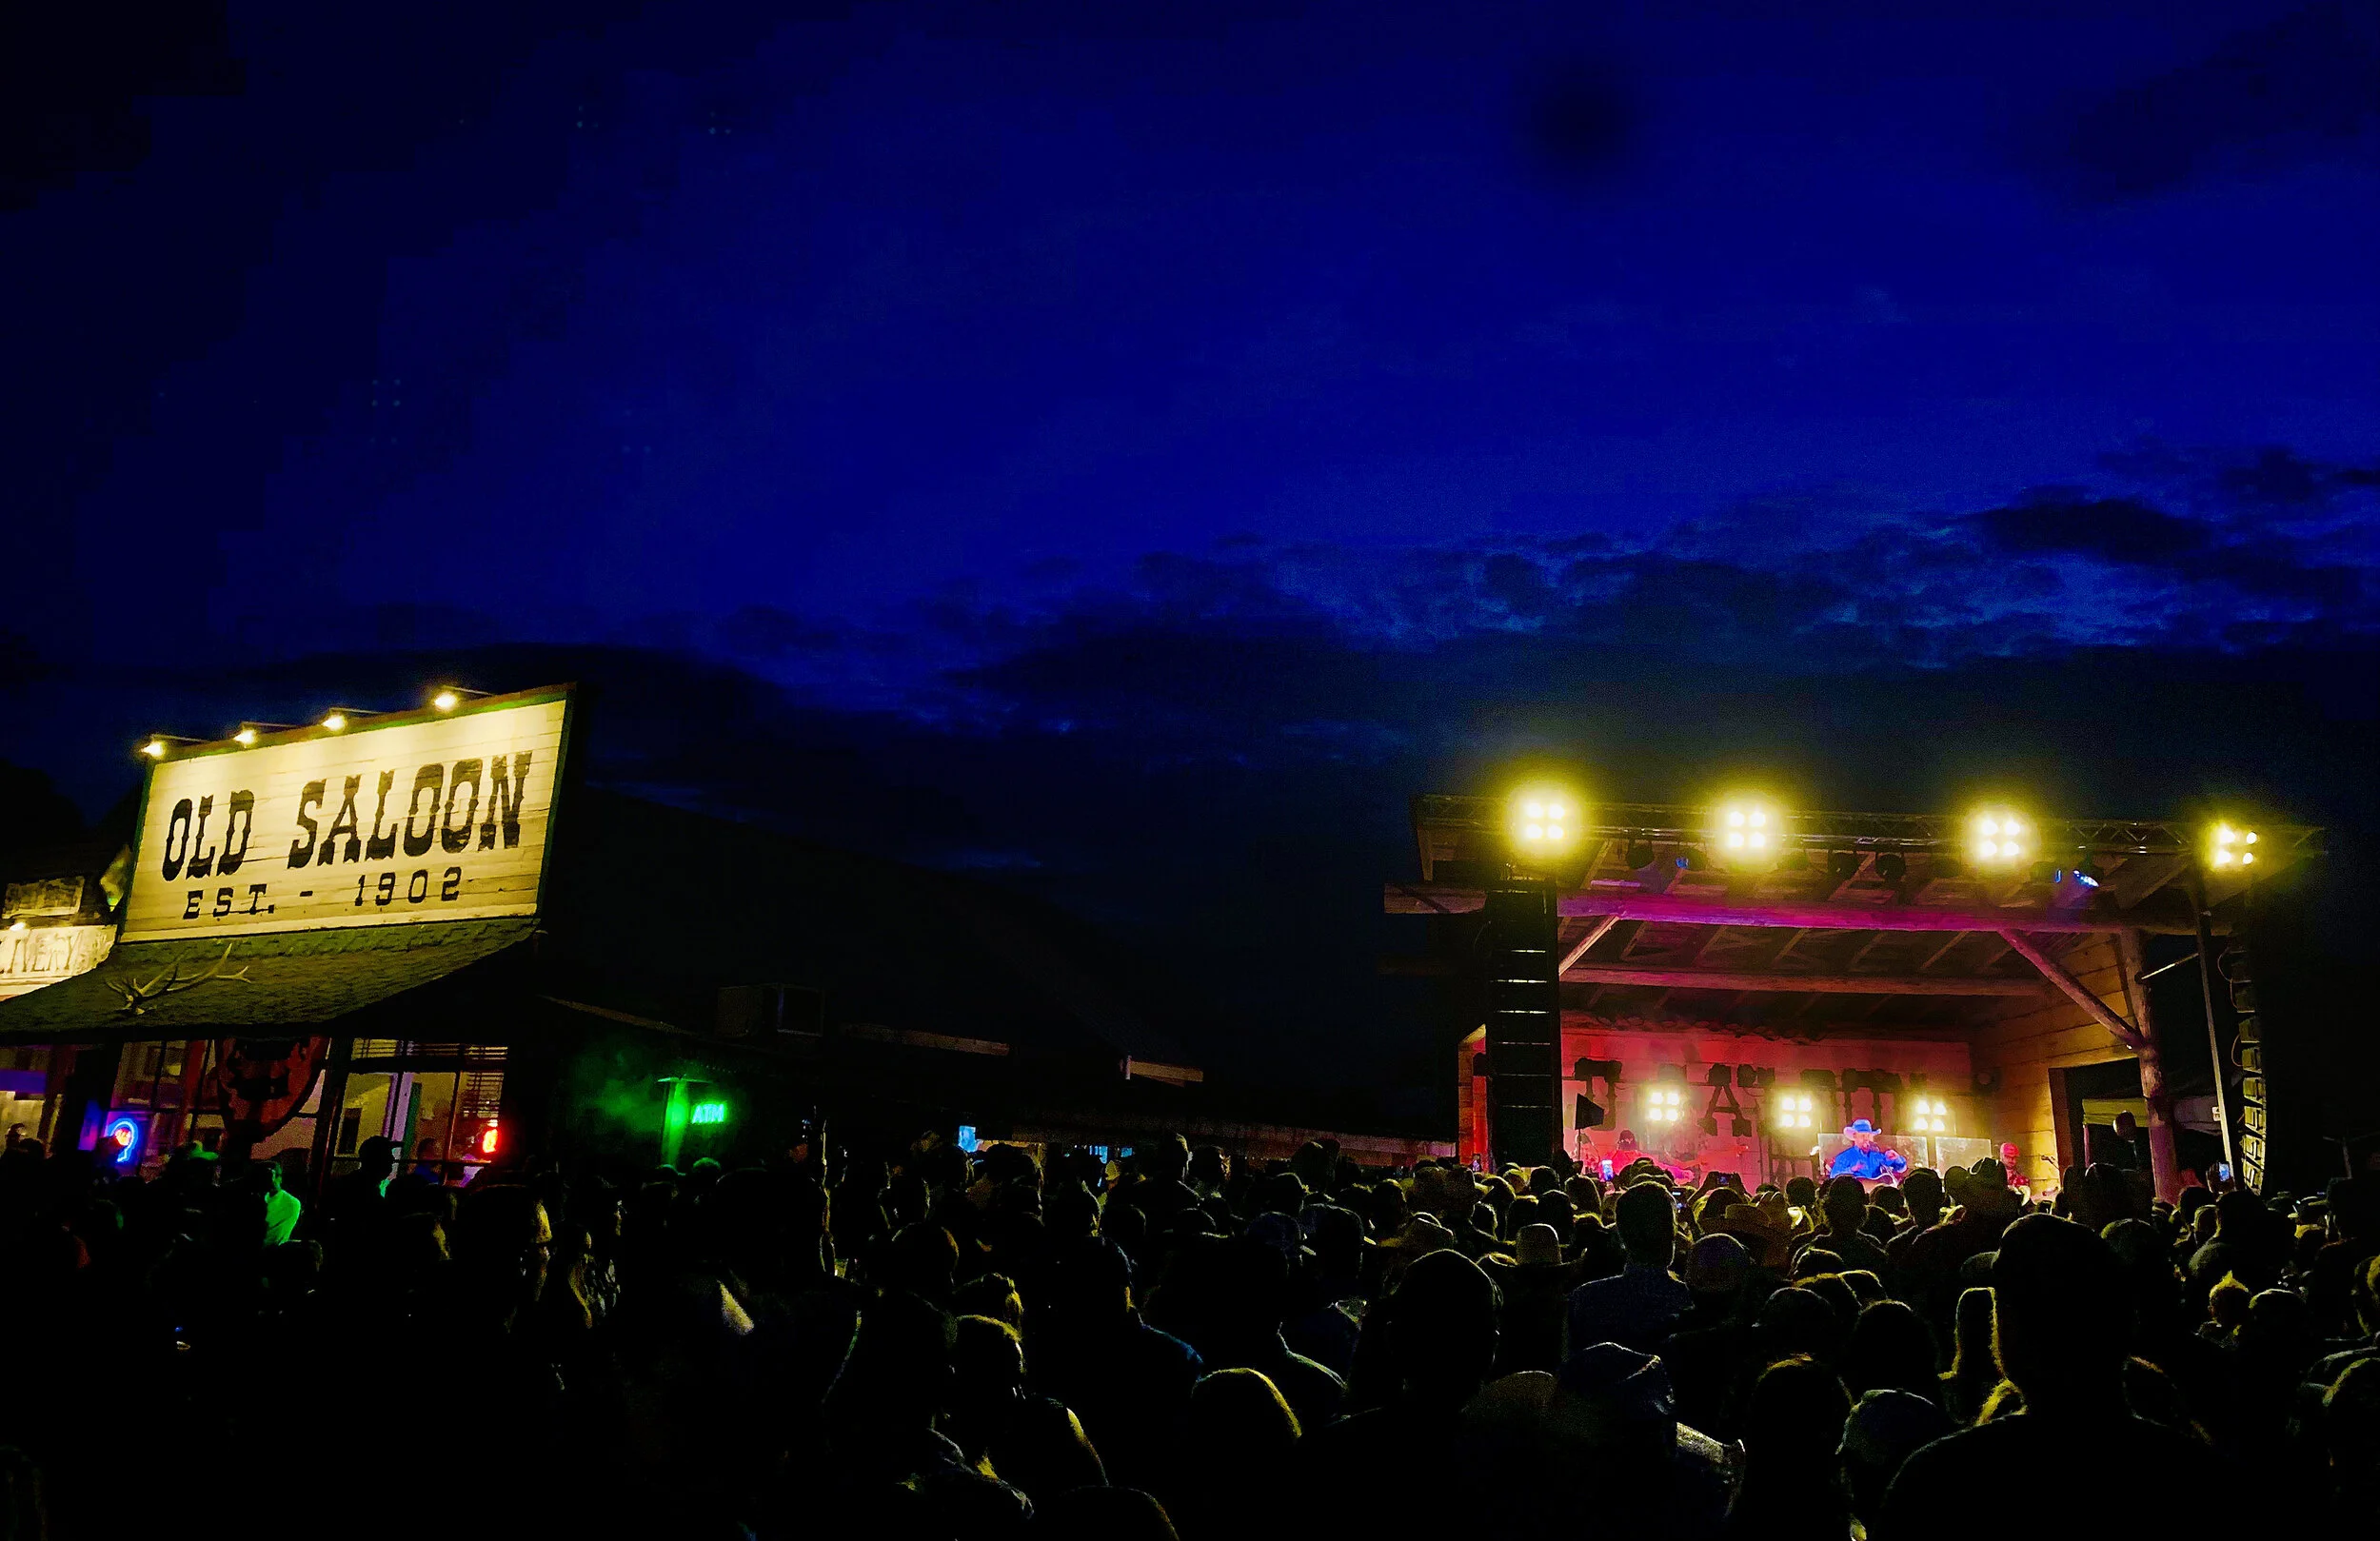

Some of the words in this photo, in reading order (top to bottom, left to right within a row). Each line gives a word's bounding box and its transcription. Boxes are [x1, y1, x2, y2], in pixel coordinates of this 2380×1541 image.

[162, 789, 255, 881] OLD
[287, 750, 533, 869] SALOON
[183, 883, 275, 919] EST.
[354, 866, 462, 907] 1902
[691, 1103, 725, 1124] ATM
